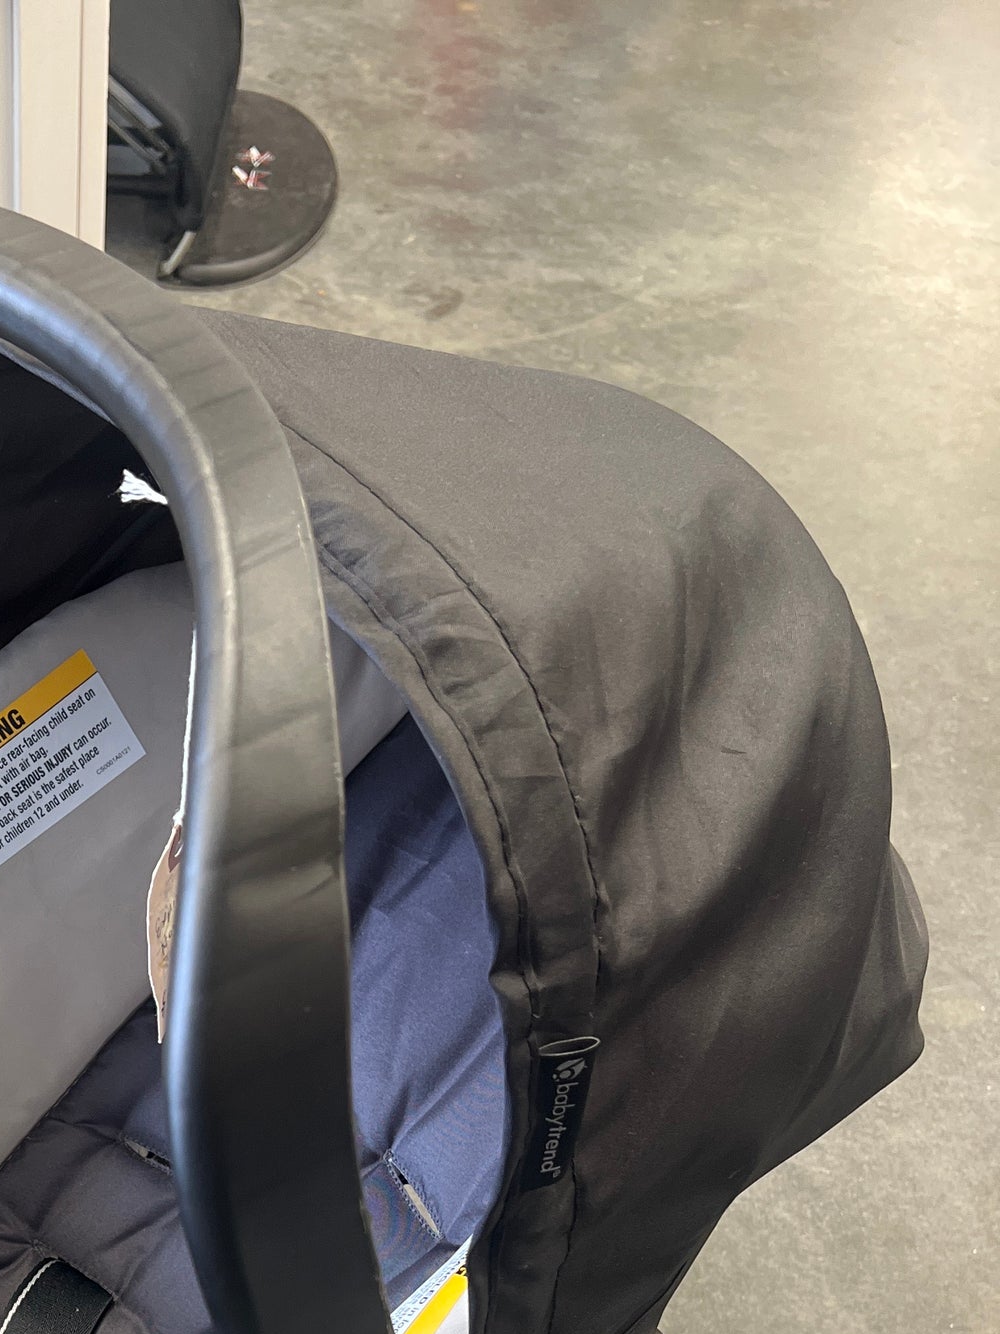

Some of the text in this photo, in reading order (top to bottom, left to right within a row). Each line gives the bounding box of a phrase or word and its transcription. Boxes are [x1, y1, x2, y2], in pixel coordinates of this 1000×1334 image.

[6, 725, 51, 762] rear-facing
[48, 707, 69, 730] child
[66, 695, 86, 715] seat
[84, 688, 97, 702] on
[11, 766, 46, 798] SERIOUS
[43, 743, 74, 773] INJURY
[72, 734, 89, 751] can
[87, 716, 112, 739] occur.
[0, 765, 21, 785] with
[18, 757, 31, 772] air
[28, 746, 49, 763] bag.
[16, 794, 36, 814] seat
[32, 789, 43, 801] is
[40, 779, 56, 795] the
[54, 760, 80, 785] safest
[77, 746, 100, 770] place
[3, 815, 36, 844] children
[33, 806, 46, 820] 12
[44, 794, 61, 813] and
[58, 778, 84, 802] under.
[539, 1081, 580, 1174] babytrend
